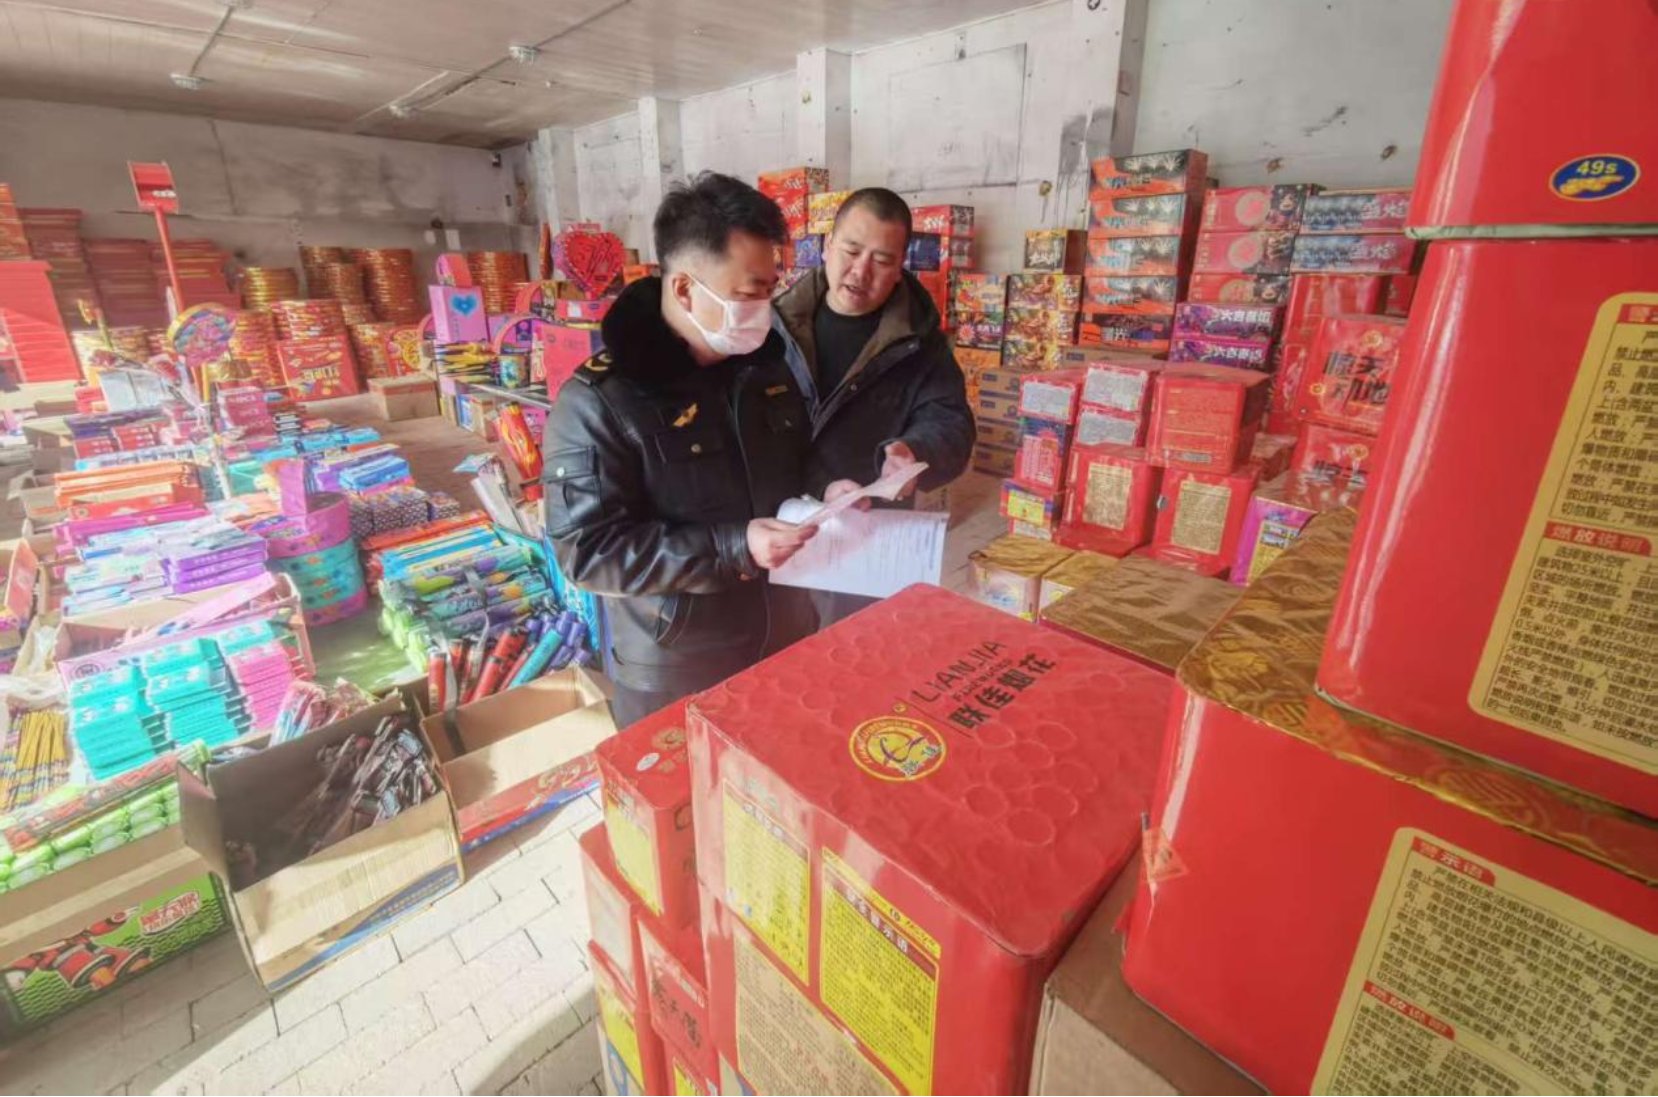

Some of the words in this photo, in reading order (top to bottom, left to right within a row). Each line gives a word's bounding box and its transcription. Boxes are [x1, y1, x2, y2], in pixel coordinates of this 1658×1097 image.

[1576, 160, 1618, 175] 49s
[911, 640, 1008, 703] LIANJIA
[947, 652, 1057, 729] 联佳烟花
